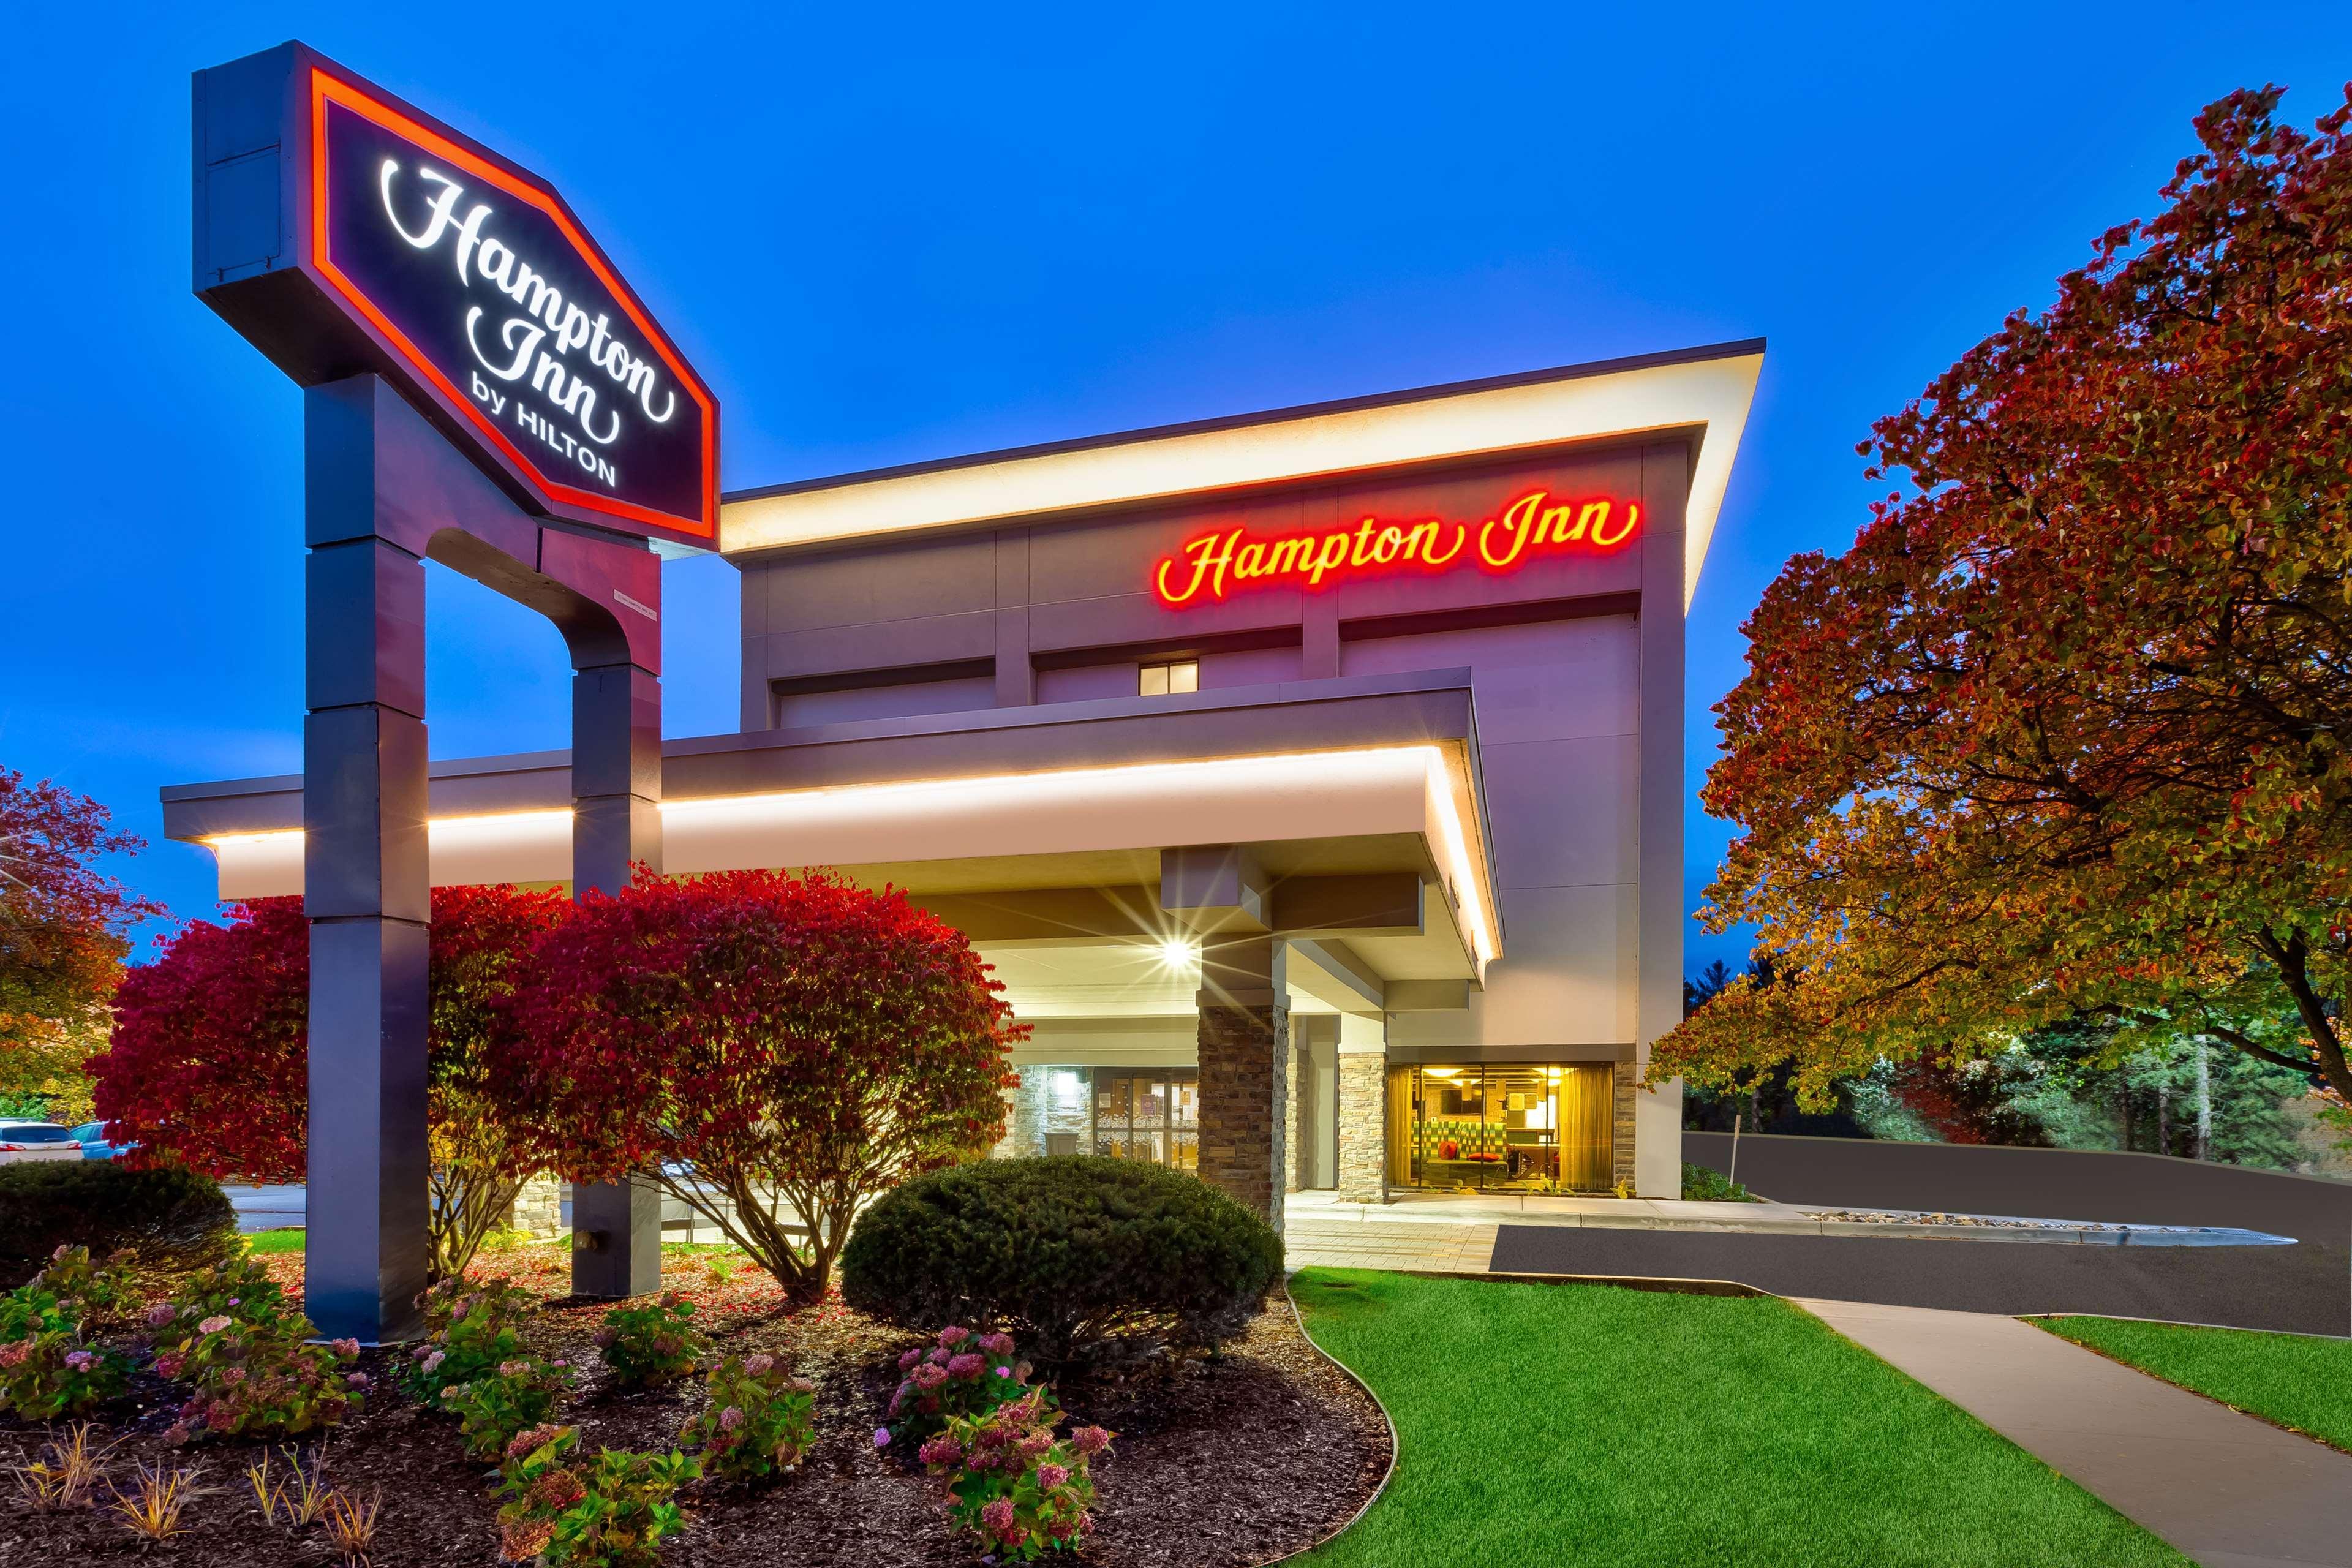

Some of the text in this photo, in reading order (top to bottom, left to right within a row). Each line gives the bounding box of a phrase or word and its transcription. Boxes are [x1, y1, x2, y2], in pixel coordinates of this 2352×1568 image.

[380, 158, 676, 423] Hampton
[466, 306, 620, 445] Inn
[472, 371, 615, 487] by HILTON
[1158, 491, 1638, 602] Hampton Inn
